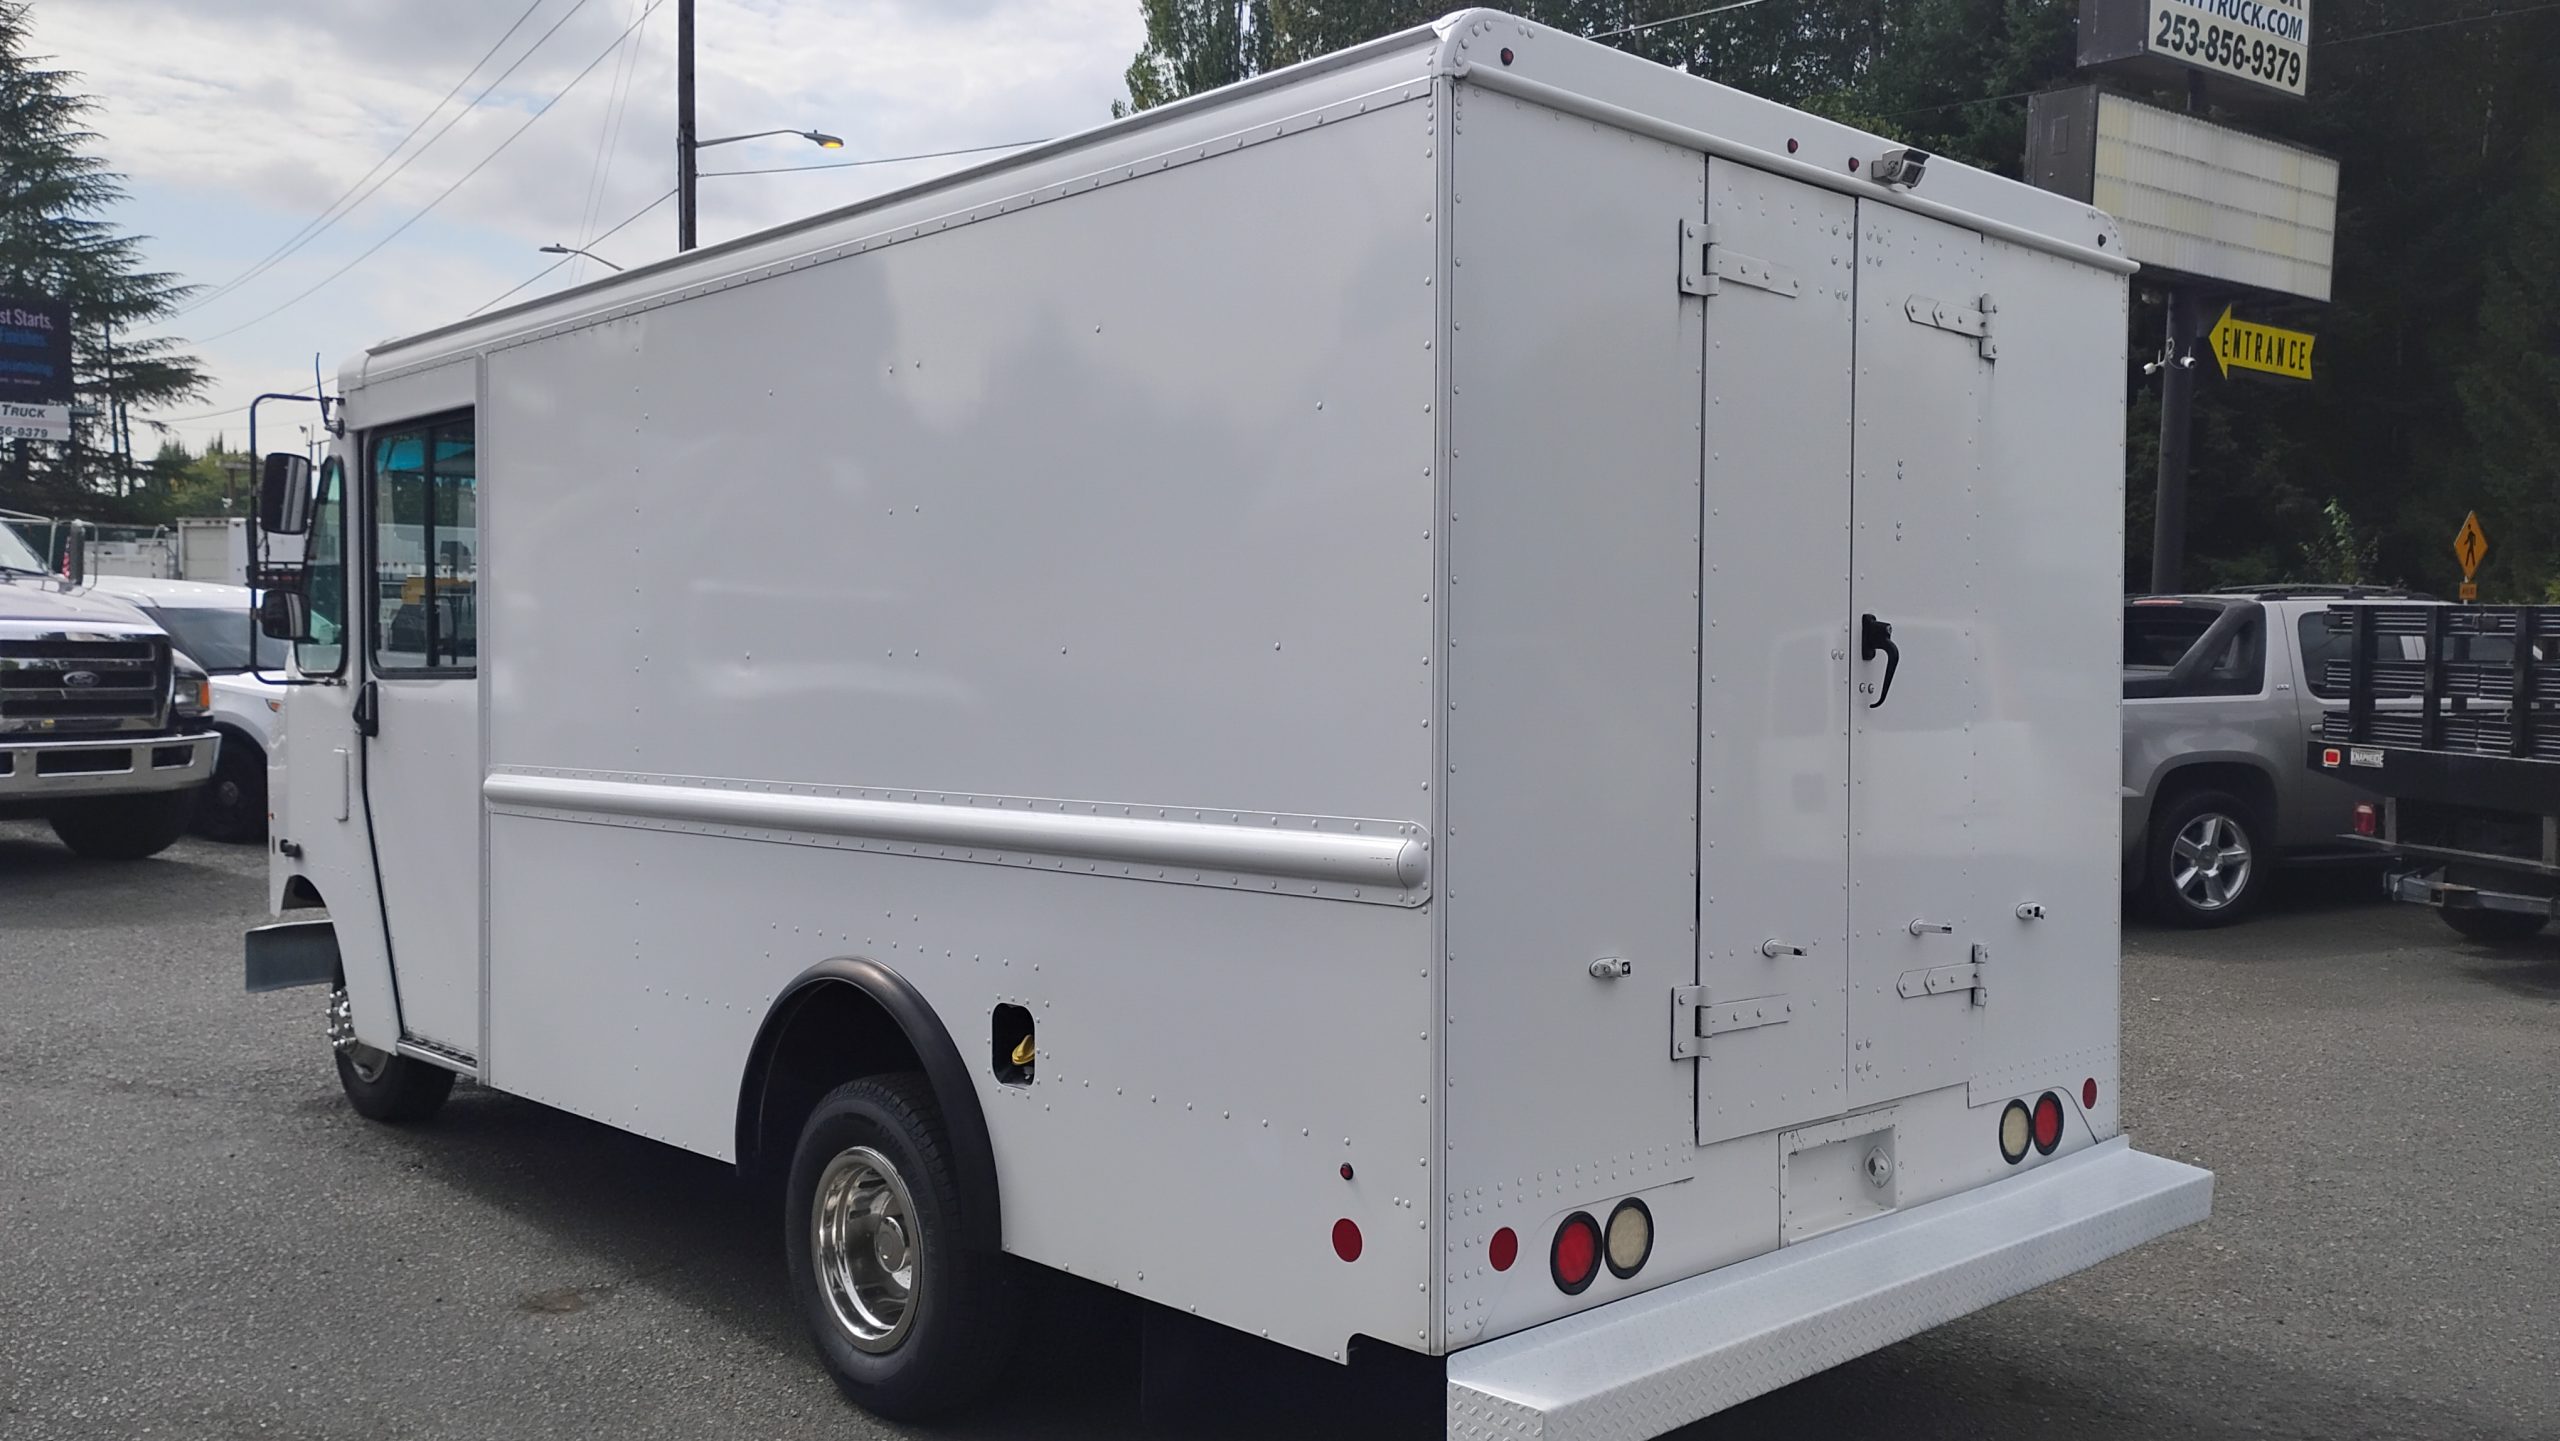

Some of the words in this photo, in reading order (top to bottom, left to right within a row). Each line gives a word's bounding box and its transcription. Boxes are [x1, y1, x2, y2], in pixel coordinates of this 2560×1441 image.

[2156, 10, 2300, 87] 253-856-9379
[2222, 327, 2306, 371] ENTRANCE
[2, 404, 46, 418] TRUCK
